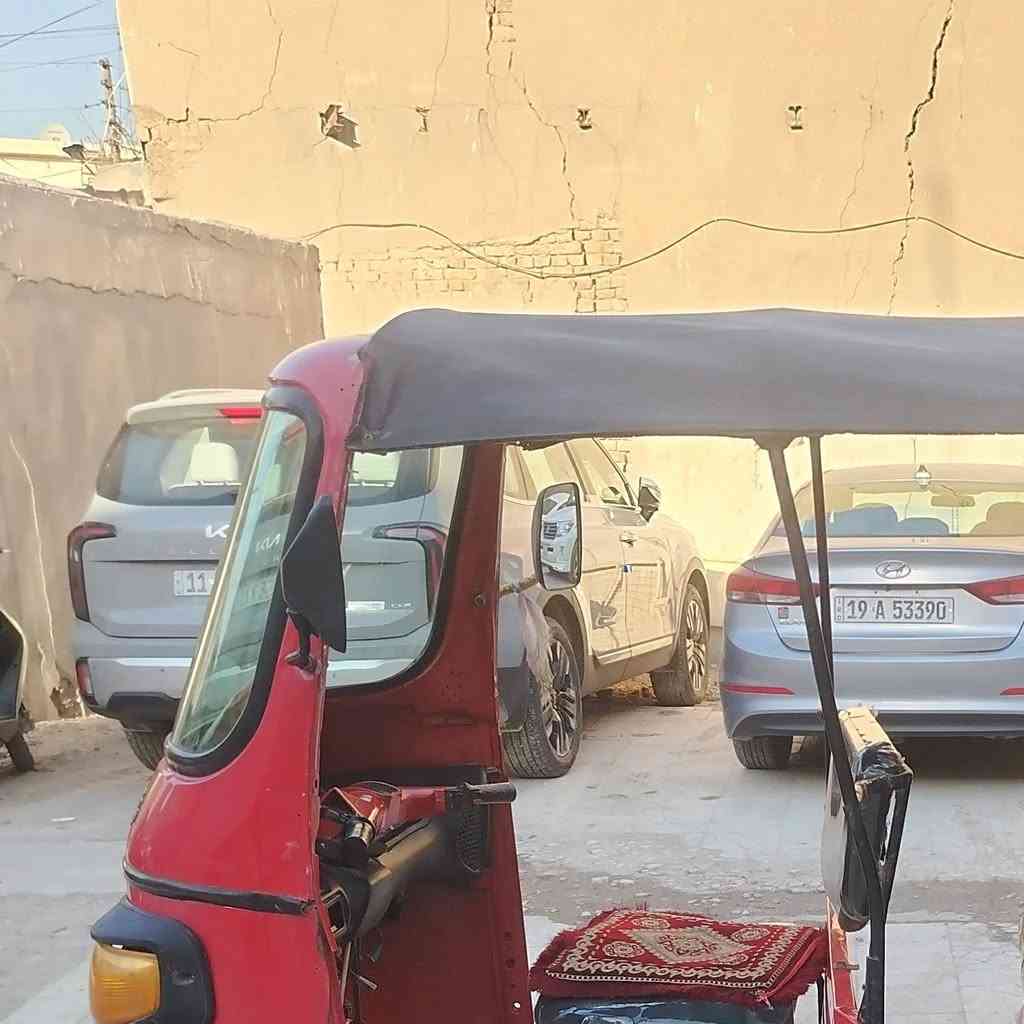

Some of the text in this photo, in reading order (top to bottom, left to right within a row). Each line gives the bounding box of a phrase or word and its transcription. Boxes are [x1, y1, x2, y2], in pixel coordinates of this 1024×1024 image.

[847, 600, 946, 620] 19 A 53390
